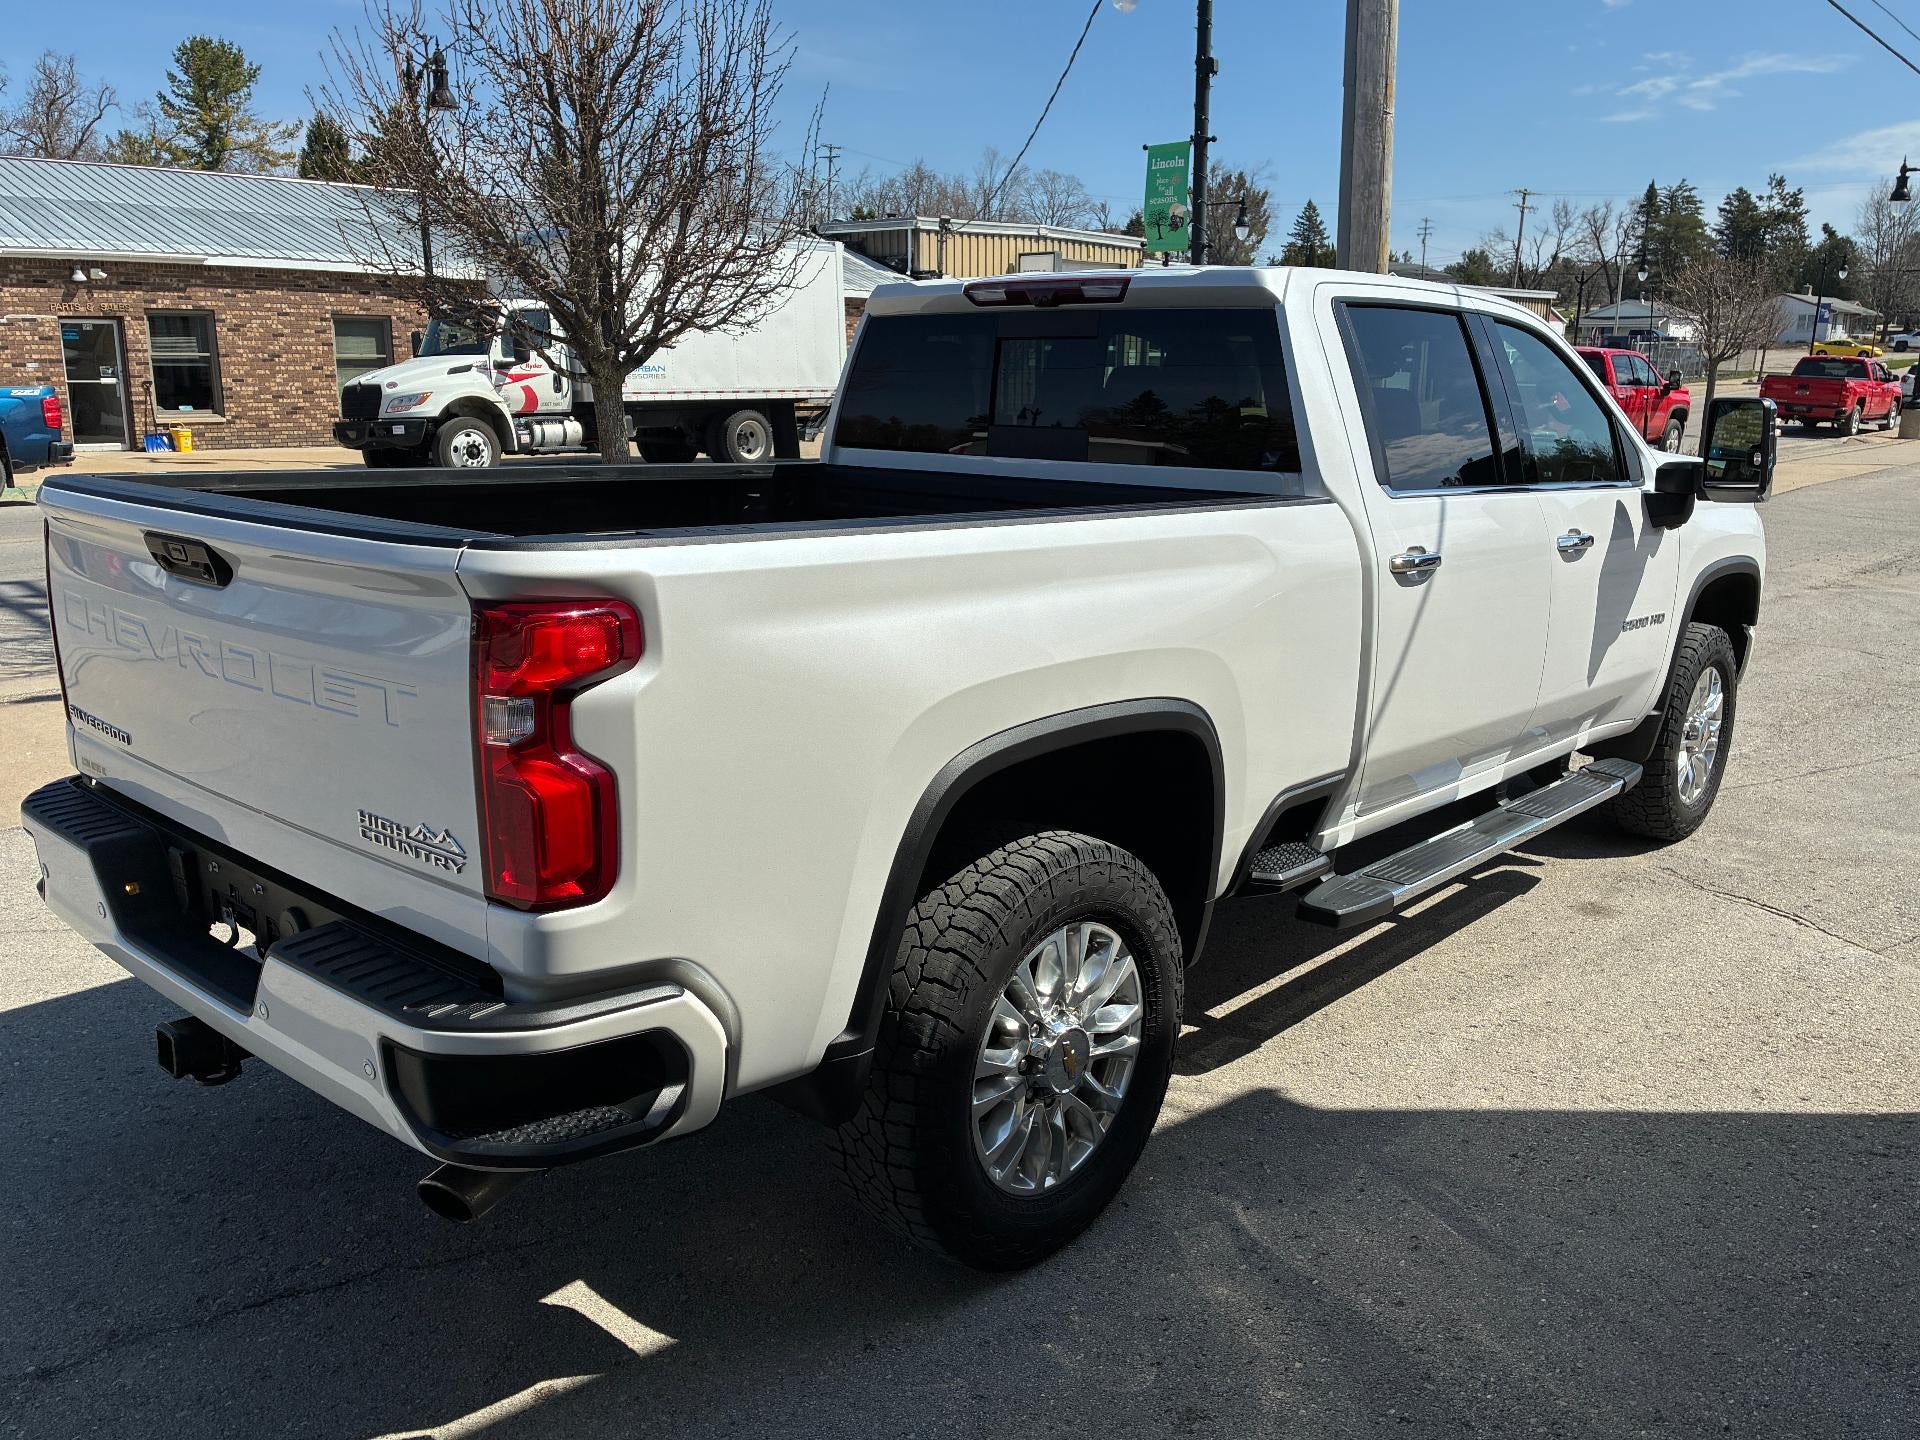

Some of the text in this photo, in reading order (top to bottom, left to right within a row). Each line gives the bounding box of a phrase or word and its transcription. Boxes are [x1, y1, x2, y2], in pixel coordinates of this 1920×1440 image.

[1151, 156, 1184, 170] Lincoln
[1164, 185, 1174, 196] all
[1150, 196, 1178, 205] seasons
[50, 302, 131, 312] PARTS & SALES
[635, 365, 666, 373] RBAN
[63, 588, 418, 728] CHEVROLET
[68, 703, 133, 746] SILVERADO
[357, 808, 410, 841] HIGH
[359, 825, 467, 875] COUNTRY
